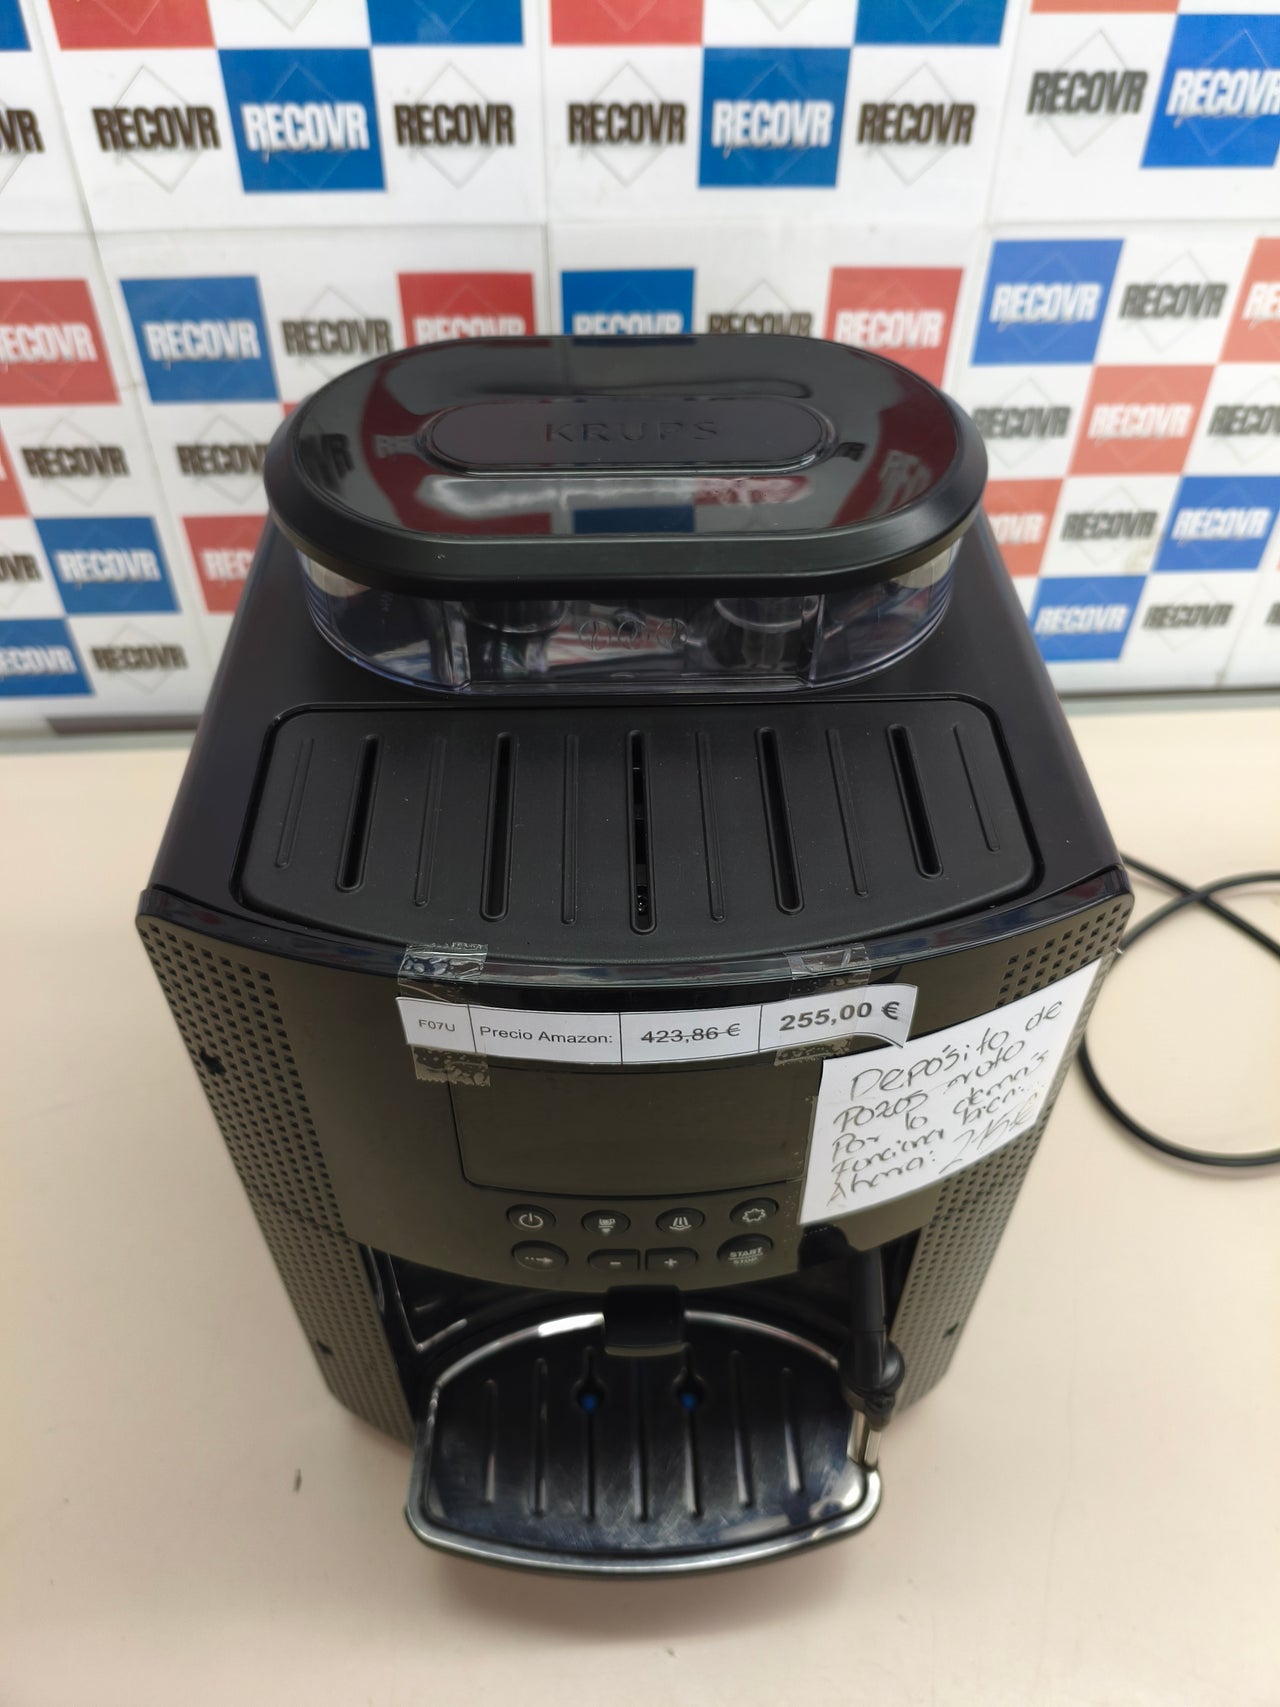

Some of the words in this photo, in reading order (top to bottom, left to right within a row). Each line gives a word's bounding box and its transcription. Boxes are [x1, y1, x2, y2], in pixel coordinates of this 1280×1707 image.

[1027, 70, 1148, 114] RECOVR
[1165, 68, 1280, 116] RECOVR
[92, 105, 221, 150] RECOVR
[242, 101, 370, 151] RECOVR
[394, 104, 515, 147] RECOVR
[568, 103, 687, 147] RECOVR
[711, 99, 834, 147] RECOVR
[857, 103, 976, 146] RECOVR
[988, 283, 1101, 322] RECOVR
[1118, 283, 1228, 319] RECOVR
[142, 319, 260, 360] RECOVR
[281, 318, 392, 354] RECOVR
[834, 310, 945, 349] RECOVR
[546, 420, 719, 443] KRUPS
[972, 404, 1072, 438] RECOVR
[1087, 403, 1194, 438] RECOVR
[21, 445, 130, 478] RECOVR
[176, 443, 269, 477] RECOV
[1061, 511, 1158, 541] RECOVR
[1171, 507, 1272, 540] RECOVR
[56, 549, 161, 582] RECOVR
[1034, 604, 1129, 635] RECOVR
[1143, 604, 1234, 629] RECOVR
[90, 645, 189, 672] RECOVR
[418, 1018, 456, 1032] F07U
[779, 1001, 873, 1032] 255,00
[881, 1000, 900, 1020] €
[480, 1025, 534, 1041] Precio
[538, 1031, 614, 1044] Amazon:
[641, 1028, 719, 1044] 423,86
[725, 1023, 741, 1037] €
